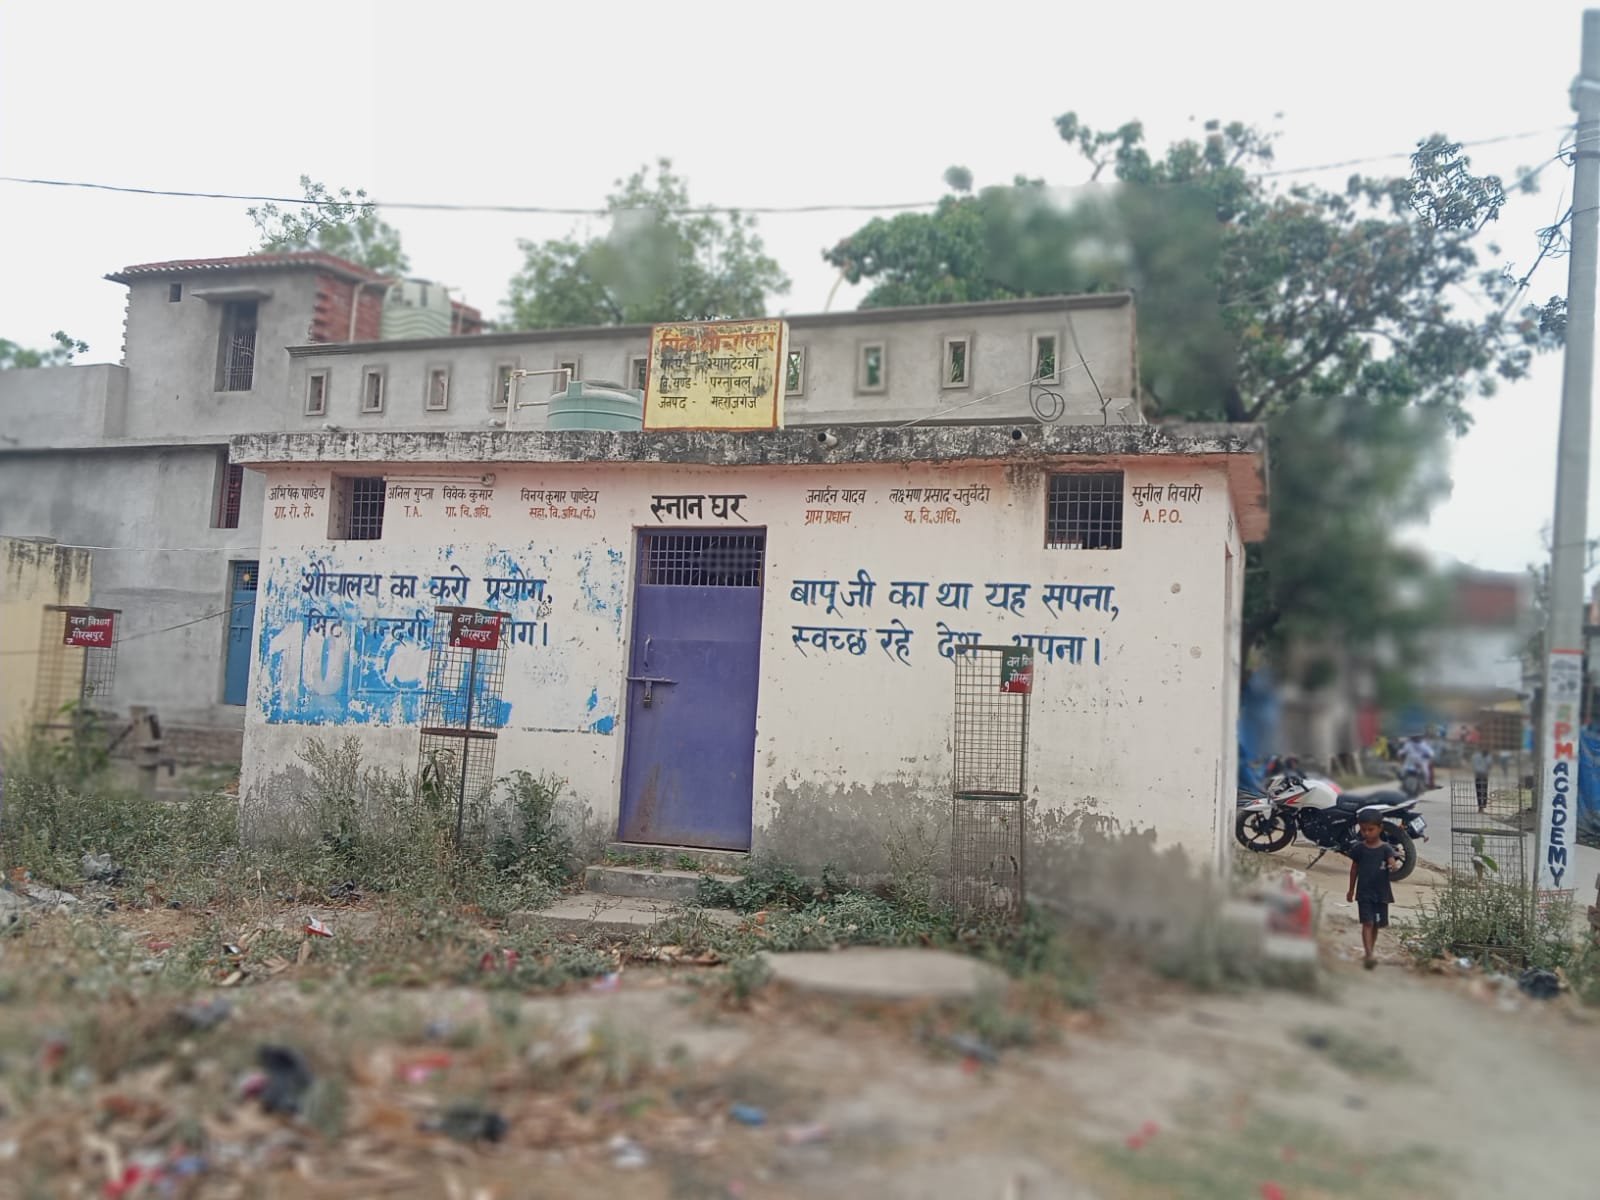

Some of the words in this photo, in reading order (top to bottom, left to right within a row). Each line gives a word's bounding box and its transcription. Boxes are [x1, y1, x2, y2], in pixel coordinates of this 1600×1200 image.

[387, 485, 411, 500] अनिल
[414, 487, 434, 504] गुप्ता
[443, 486, 466, 500] विवेक
[469, 488, 494, 503] कुमार
[520, 488, 545, 502] विनय
[545, 490, 567, 505] कुमार
[570, 488, 599, 503] पाण्डेय
[806, 486, 839, 506] जनार्दन
[841, 489, 867, 504] यादव
[889, 488, 923, 505] लक्ष्मण
[923, 487, 952, 503] प्रसाद
[952, 484, 991, 506] चतुर्वेदी
[1132, 483, 1164, 507] सुनील
[1167, 483, 1203, 504] तिवारी
[651, 495, 706, 523] स्नान
[708, 494, 748, 522] घर
[804, 510, 823, 526] ग्राम
[825, 510, 851, 525] प्रधान
[390, 575, 418, 598] का
[430, 564, 470, 605] करो
[889, 582, 929, 609] का
[936, 583, 974, 610] था
[985, 583, 1032, 618] यह
[1042, 584, 1120, 622] सपना,
[457, 613, 472, 625] वन
[474, 612, 499, 626] विभाग
[459, 625, 491, 642] गोरखपुर
[791, 626, 867, 658] स्वच्छ
[875, 618, 913, 667] रहे
[1547, 761, 1570, 888] ACADEMY
